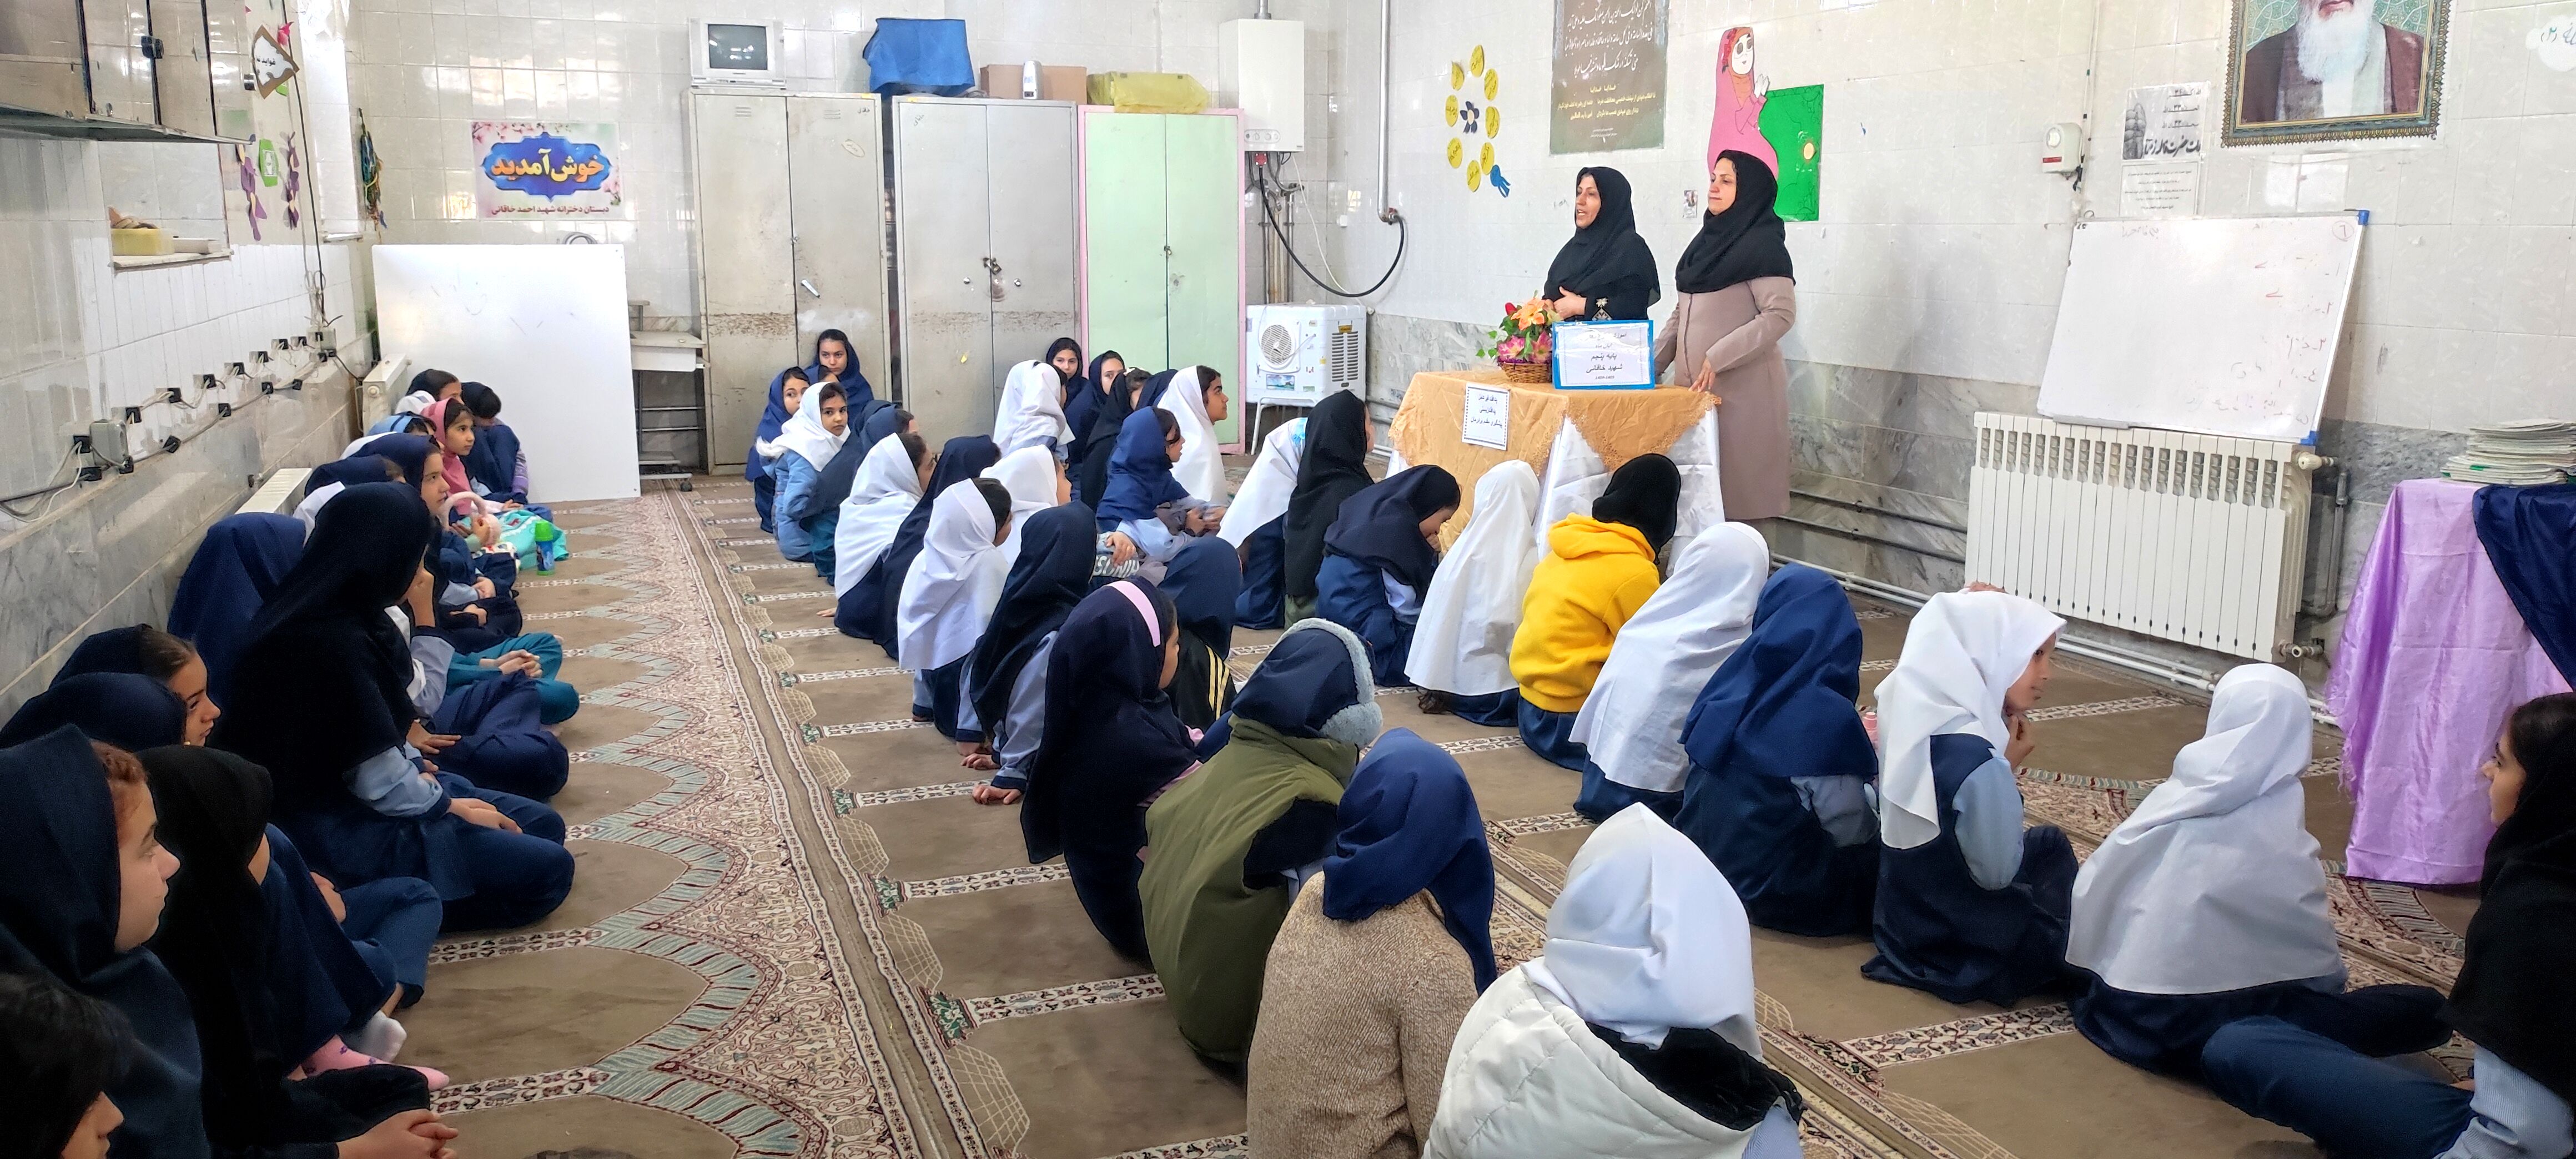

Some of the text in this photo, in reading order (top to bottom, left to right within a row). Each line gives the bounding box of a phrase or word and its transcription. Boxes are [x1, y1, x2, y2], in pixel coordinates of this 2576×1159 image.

[491, 148, 605, 183] خوش آمدید
[491, 205, 516, 215] خاقانی
[537, 205, 555, 214] شهید
[557, 206, 583, 215] دخترانه
[585, 206, 610, 215] دبستان
[1591, 352, 1617, 361] پایه پنجم
[1586, 364, 1623, 374] شهید خاقانی
